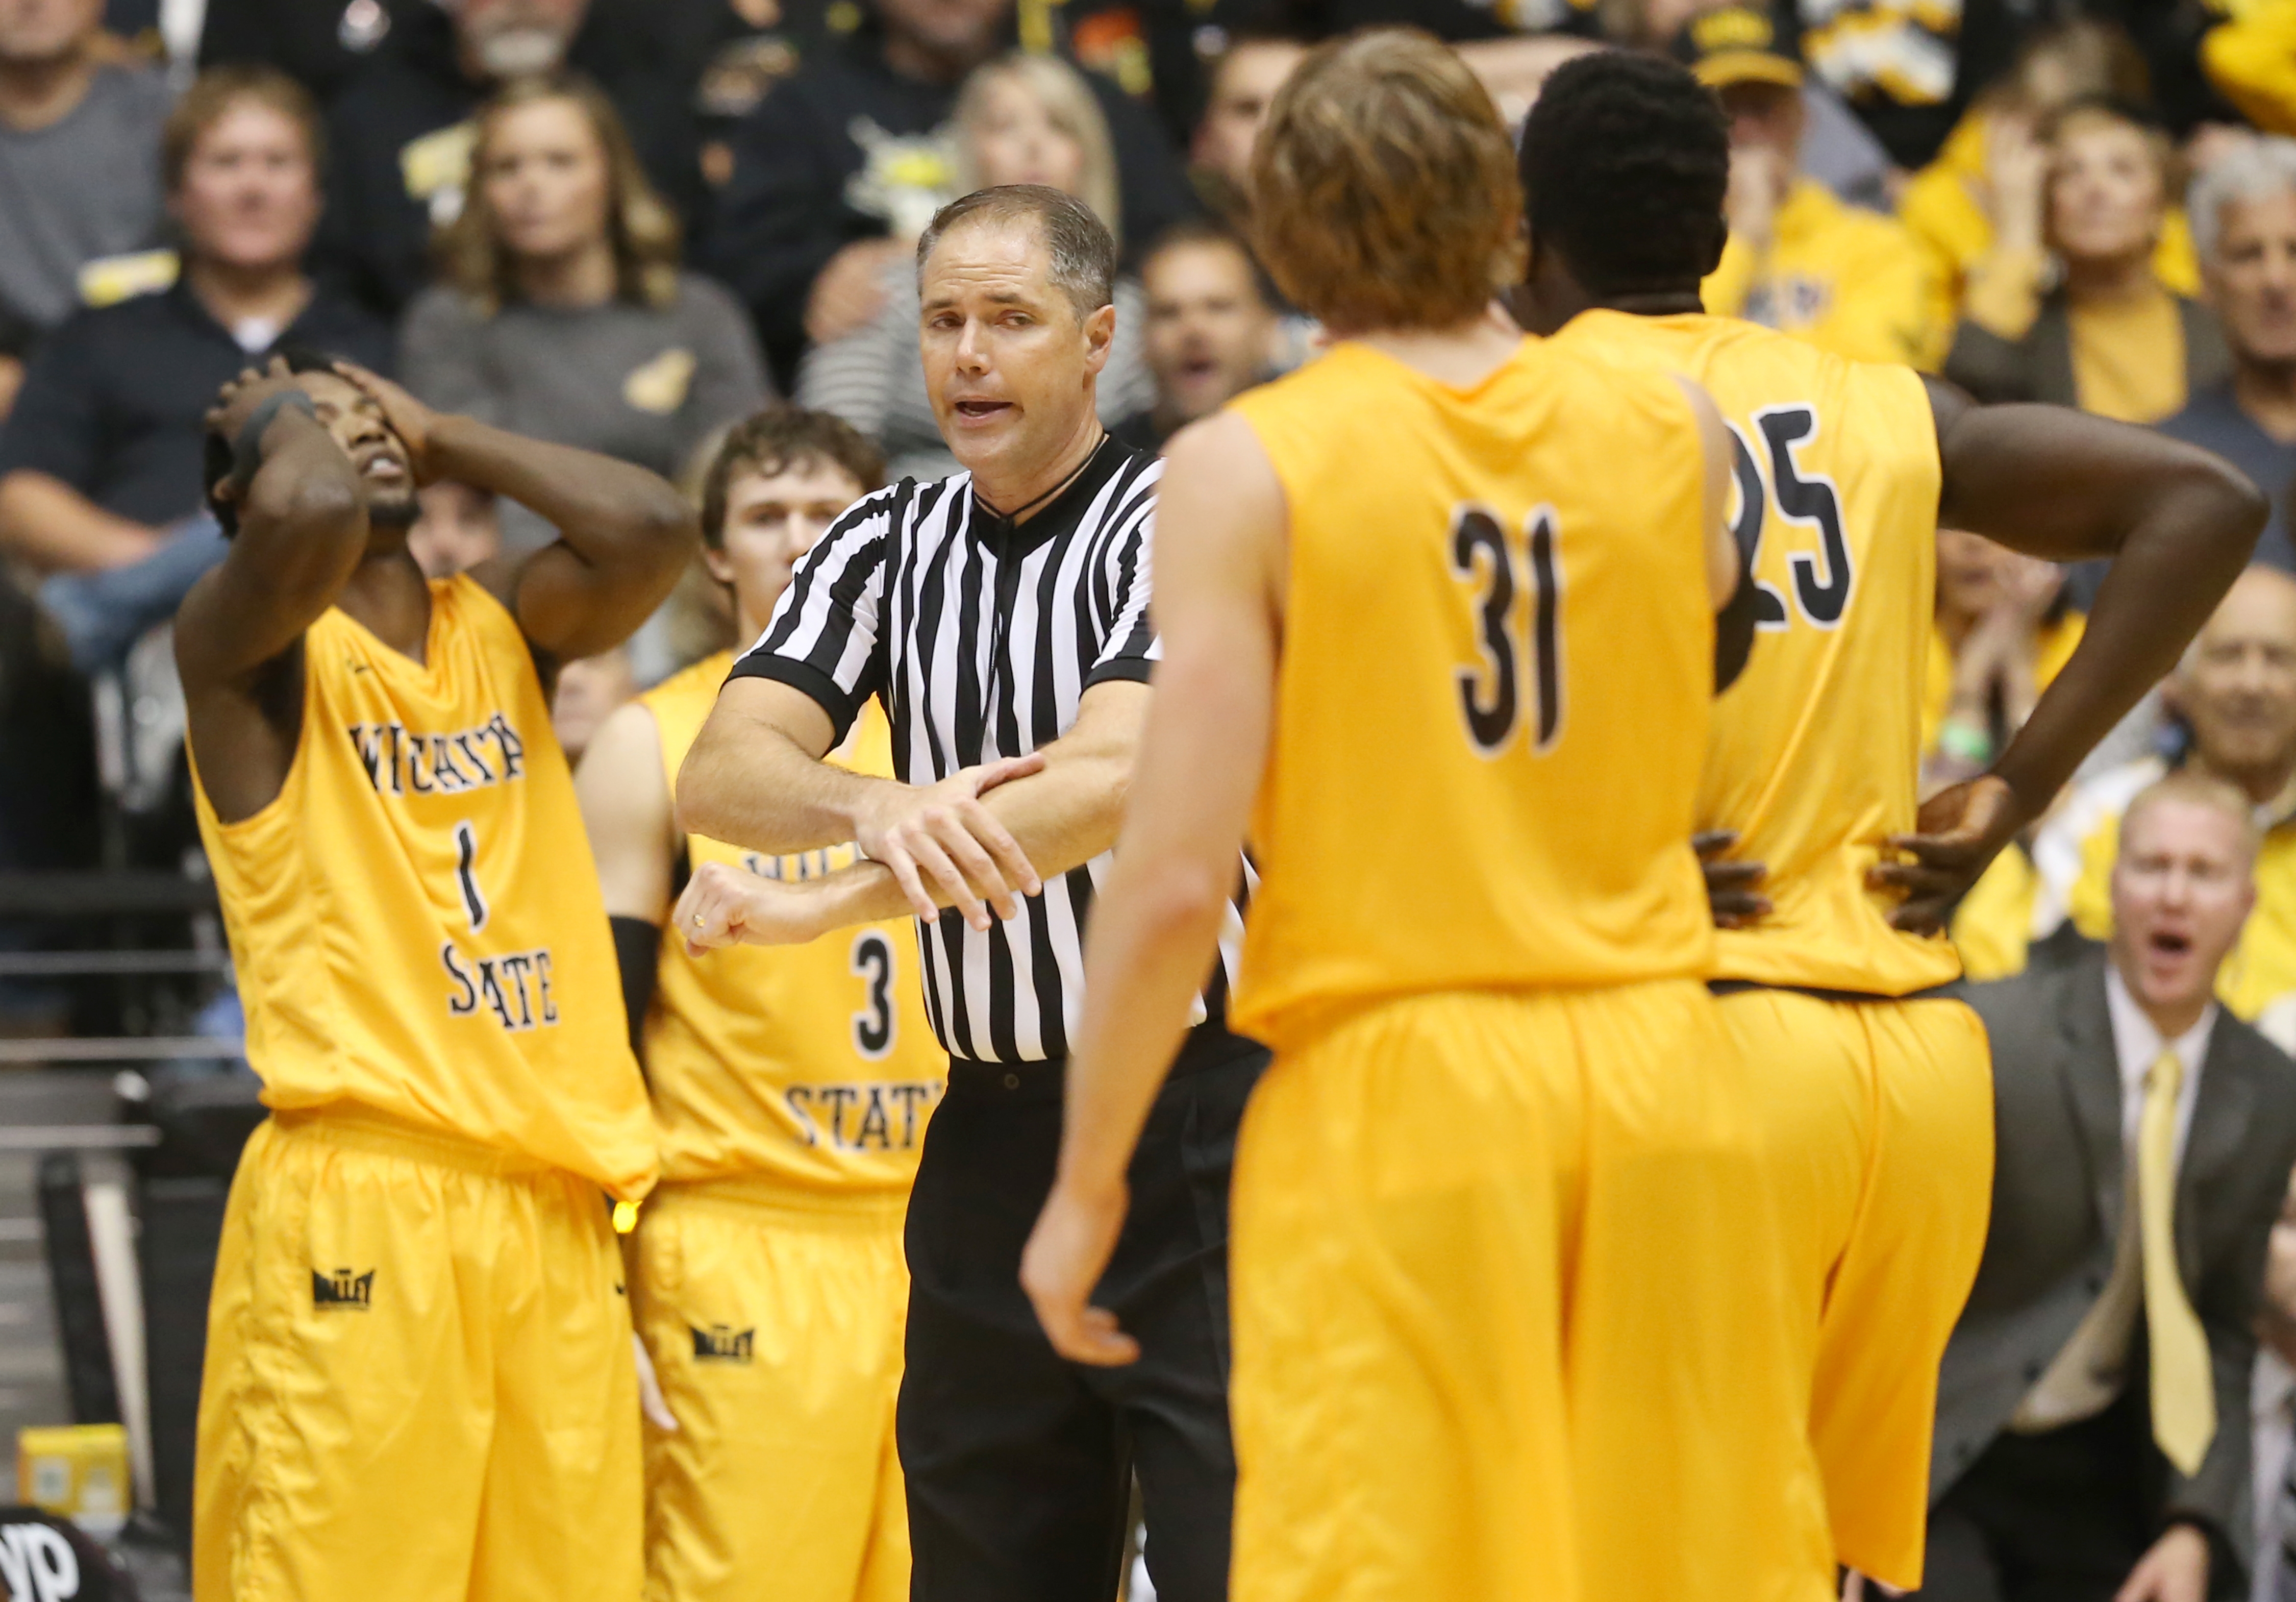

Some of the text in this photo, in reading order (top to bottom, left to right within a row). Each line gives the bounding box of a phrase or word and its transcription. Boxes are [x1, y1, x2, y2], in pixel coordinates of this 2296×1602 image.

[1721, 403, 1852, 631] 25
[1451, 503, 1561, 755] 31
[456, 822, 486, 931] 1
[441, 941, 558, 1030] SATE
[851, 930, 895, 1058] 3
[785, 1083, 943, 1151] STAT
